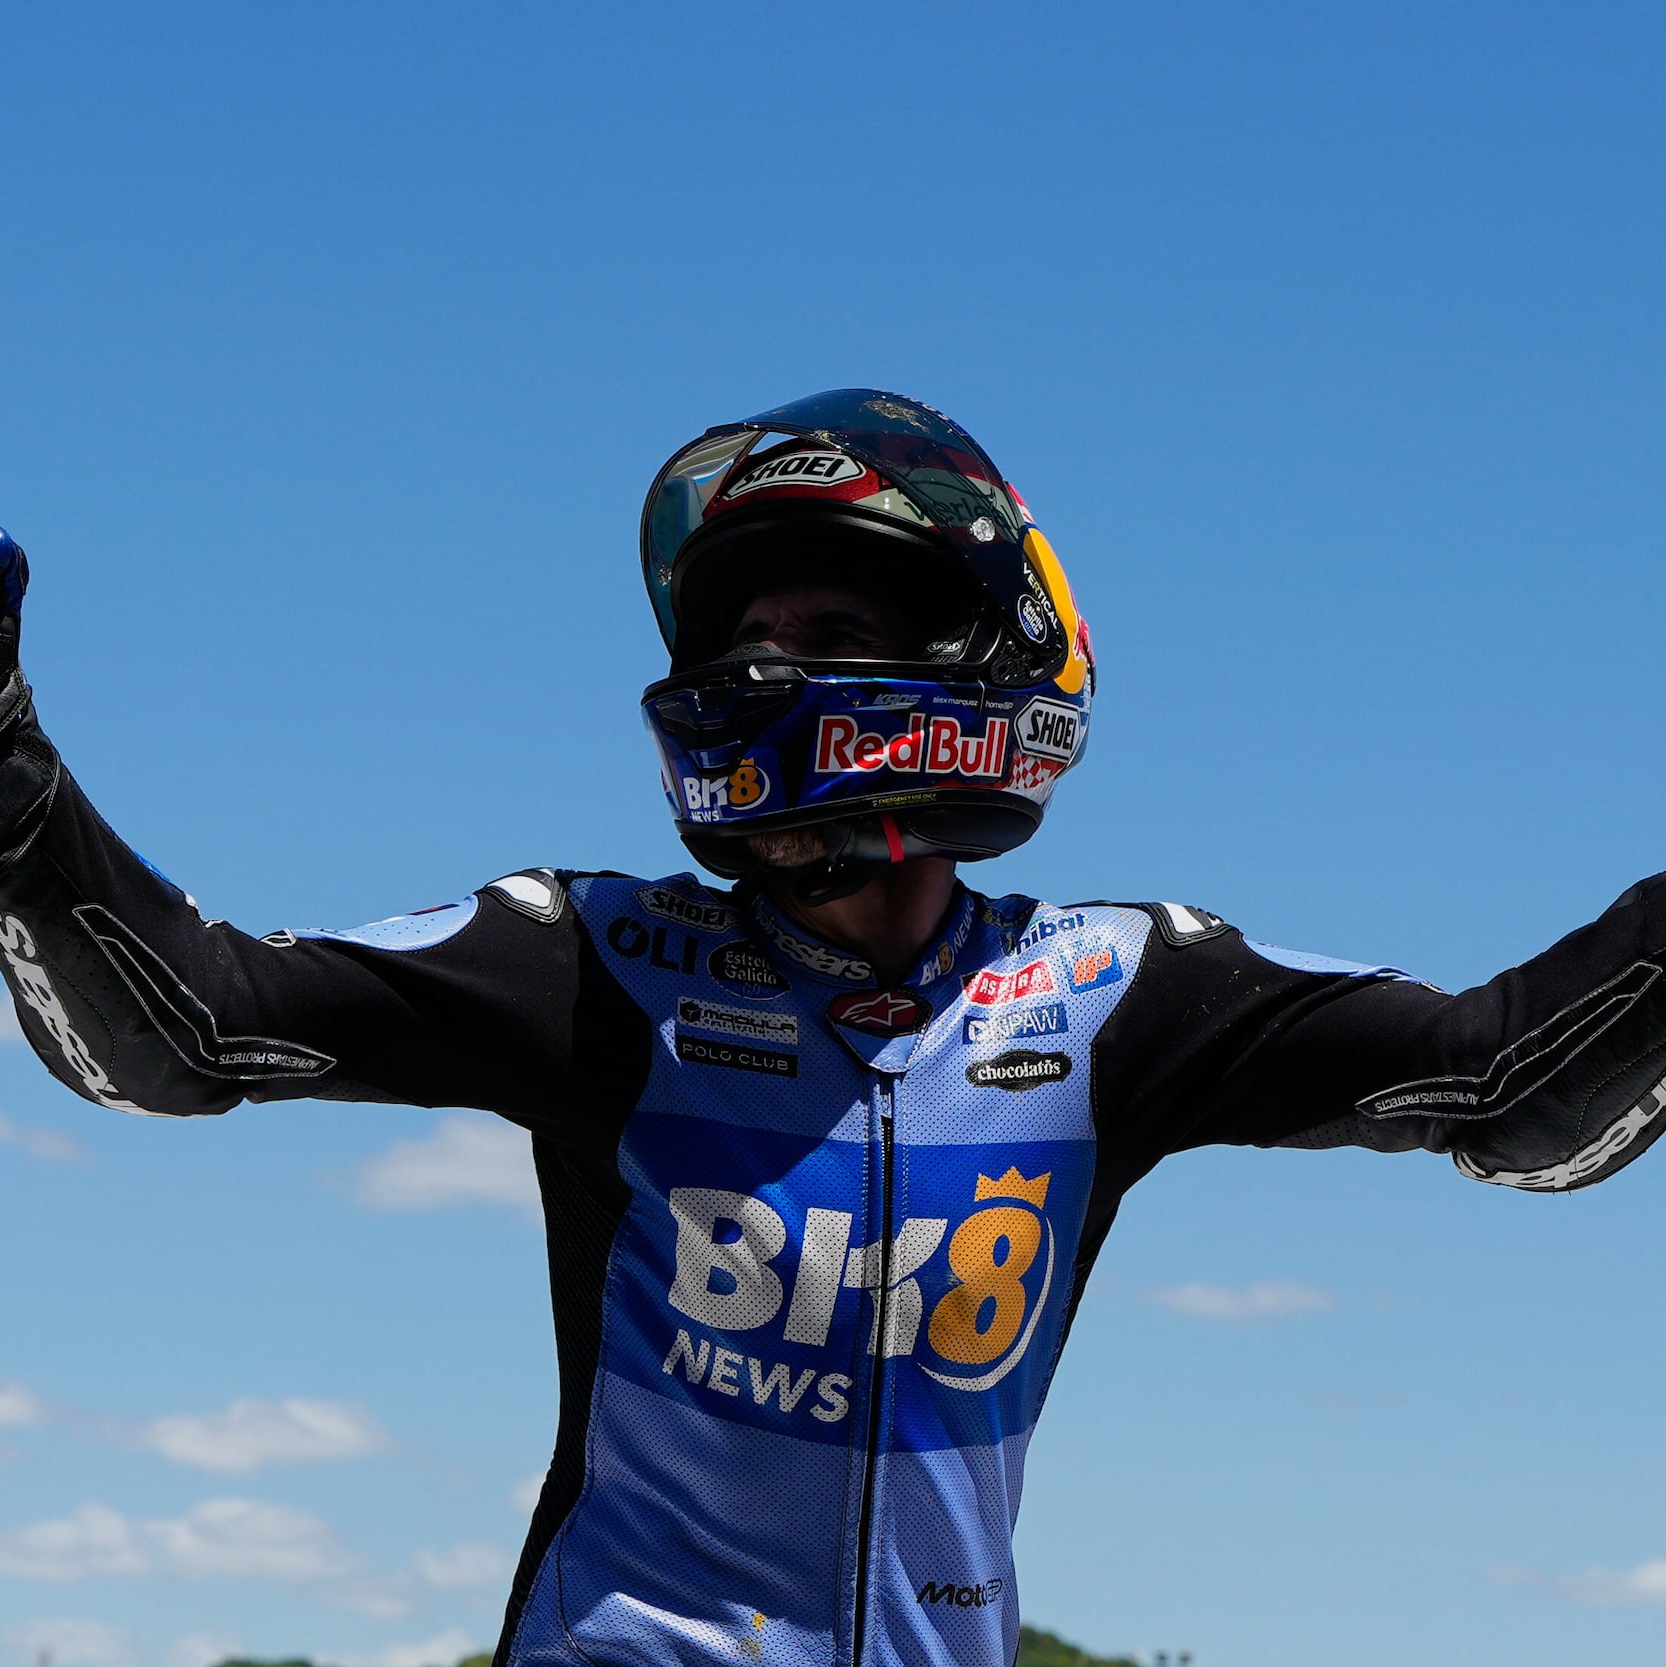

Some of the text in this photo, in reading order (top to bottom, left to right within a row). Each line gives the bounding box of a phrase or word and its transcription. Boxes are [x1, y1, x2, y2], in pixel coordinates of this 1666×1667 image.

[735, 455, 846, 492] SHOEI
[1022, 561, 1059, 630] VERTICAL
[816, 713, 1010, 777] Red Bull
[1026, 709, 1077, 751] SHOEI
[683, 765, 763, 809] BK8
[691, 810, 720, 823] NEWS
[650, 889, 727, 926] SHOEI
[752, 893, 872, 981] pinestars
[1014, 912, 1089, 957] nibat
[724, 966, 777, 985] Galicia
[218, 1051, 320, 1071] ALPINESTARS PROTECTS
[683, 1043, 789, 1071] POLO CLUB
[1373, 1091, 1480, 1112] ALPINESTARS PROTECTS
[668, 1187, 1044, 1366] BK8
[661, 1327, 854, 1424] NEWS
